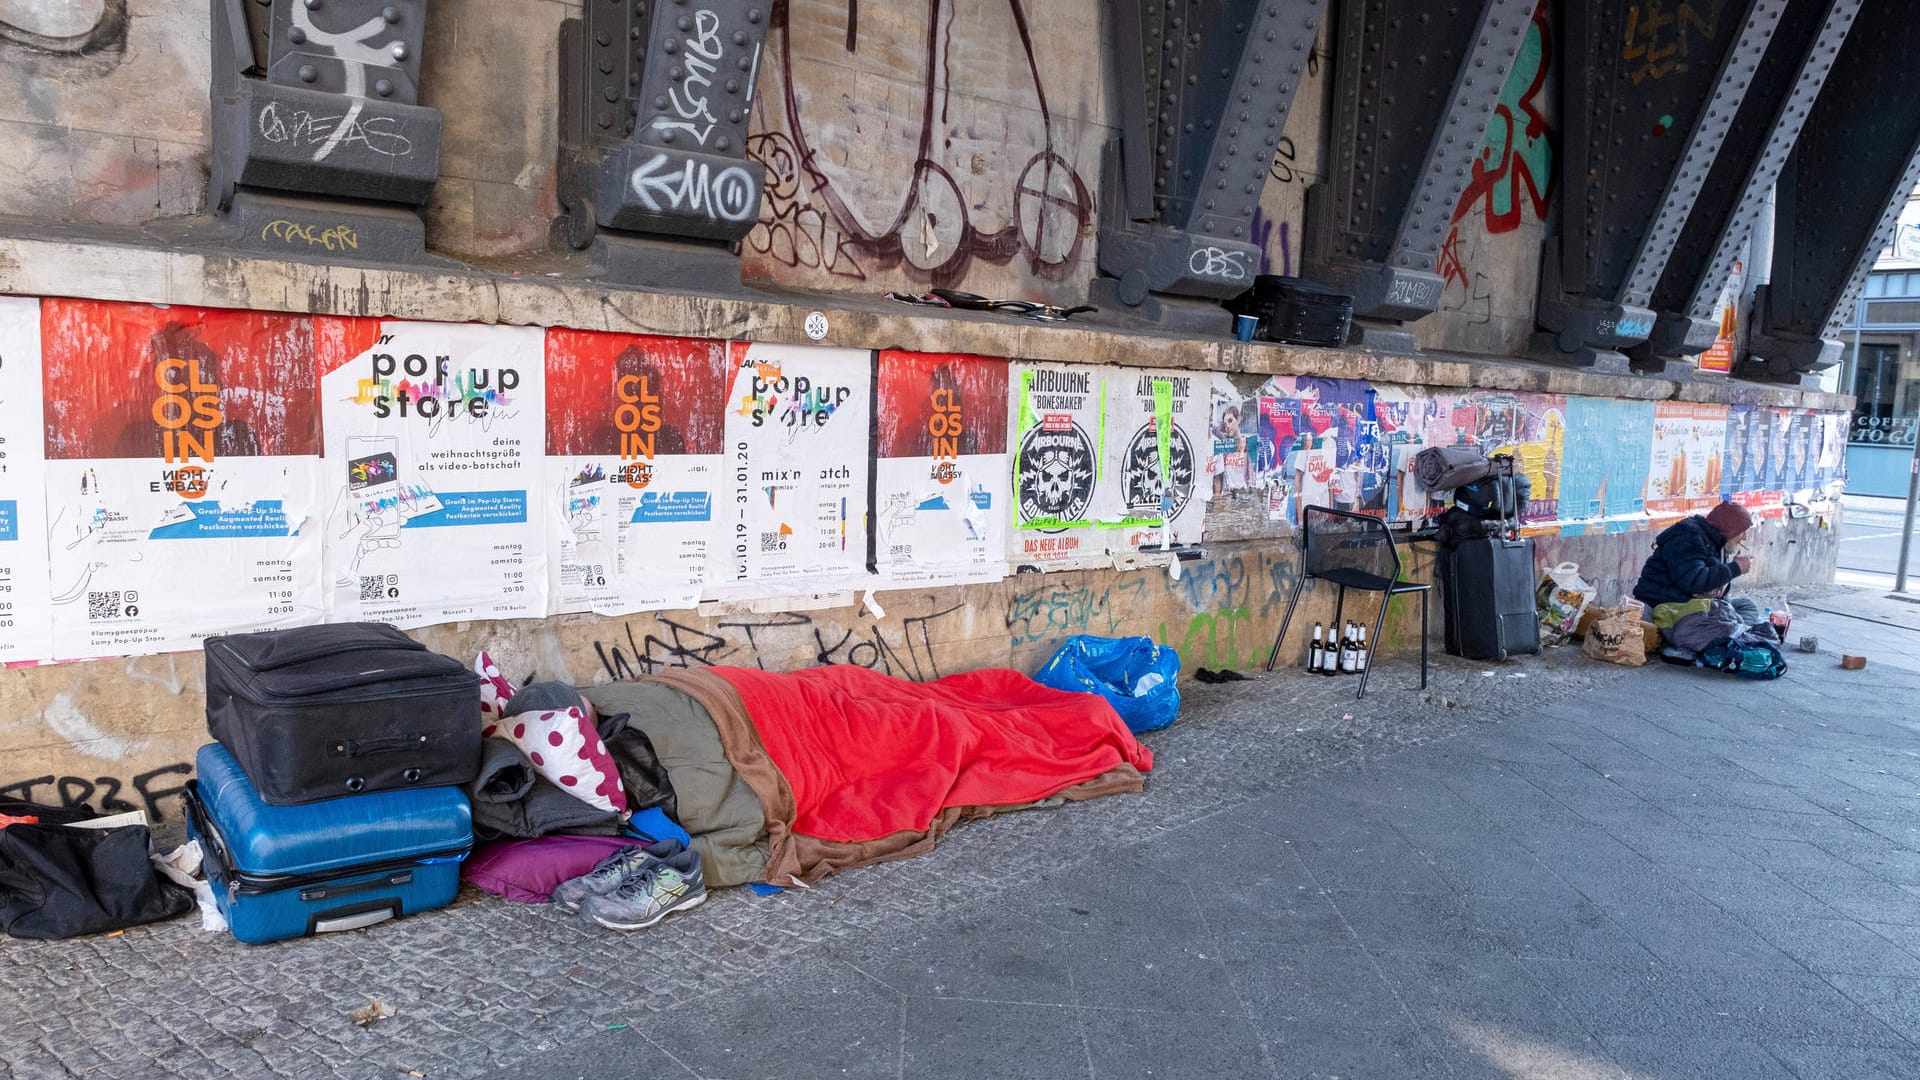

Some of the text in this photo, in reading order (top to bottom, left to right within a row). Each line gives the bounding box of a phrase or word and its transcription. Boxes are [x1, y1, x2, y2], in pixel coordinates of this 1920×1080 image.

[373, 390, 489, 419] store
[1857, 428, 1884, 442] TO
[493, 437, 521, 446] deine
[431, 448, 521, 460] weihnachtsgrüße
[418, 460, 521, 471] als video-botschaft
[219, 515, 263, 523] Augmented
[198, 523, 242, 531] Postkarten
[494, 543, 522, 551] montag
[1057, 536, 1079, 550] ALBUM
[257, 559, 292, 568] montag
[253, 574, 292, 583] samstag
[504, 571, 523, 580] 11:00
[503, 585, 524, 593] 20:00
[268, 590, 292, 598] 11:00
[267, 605, 294, 615] 20:00
[91, 626, 159, 638] #lamygoespopup
[91, 639, 111, 647] Lamy
[114, 636, 143, 645] Pop-Up
